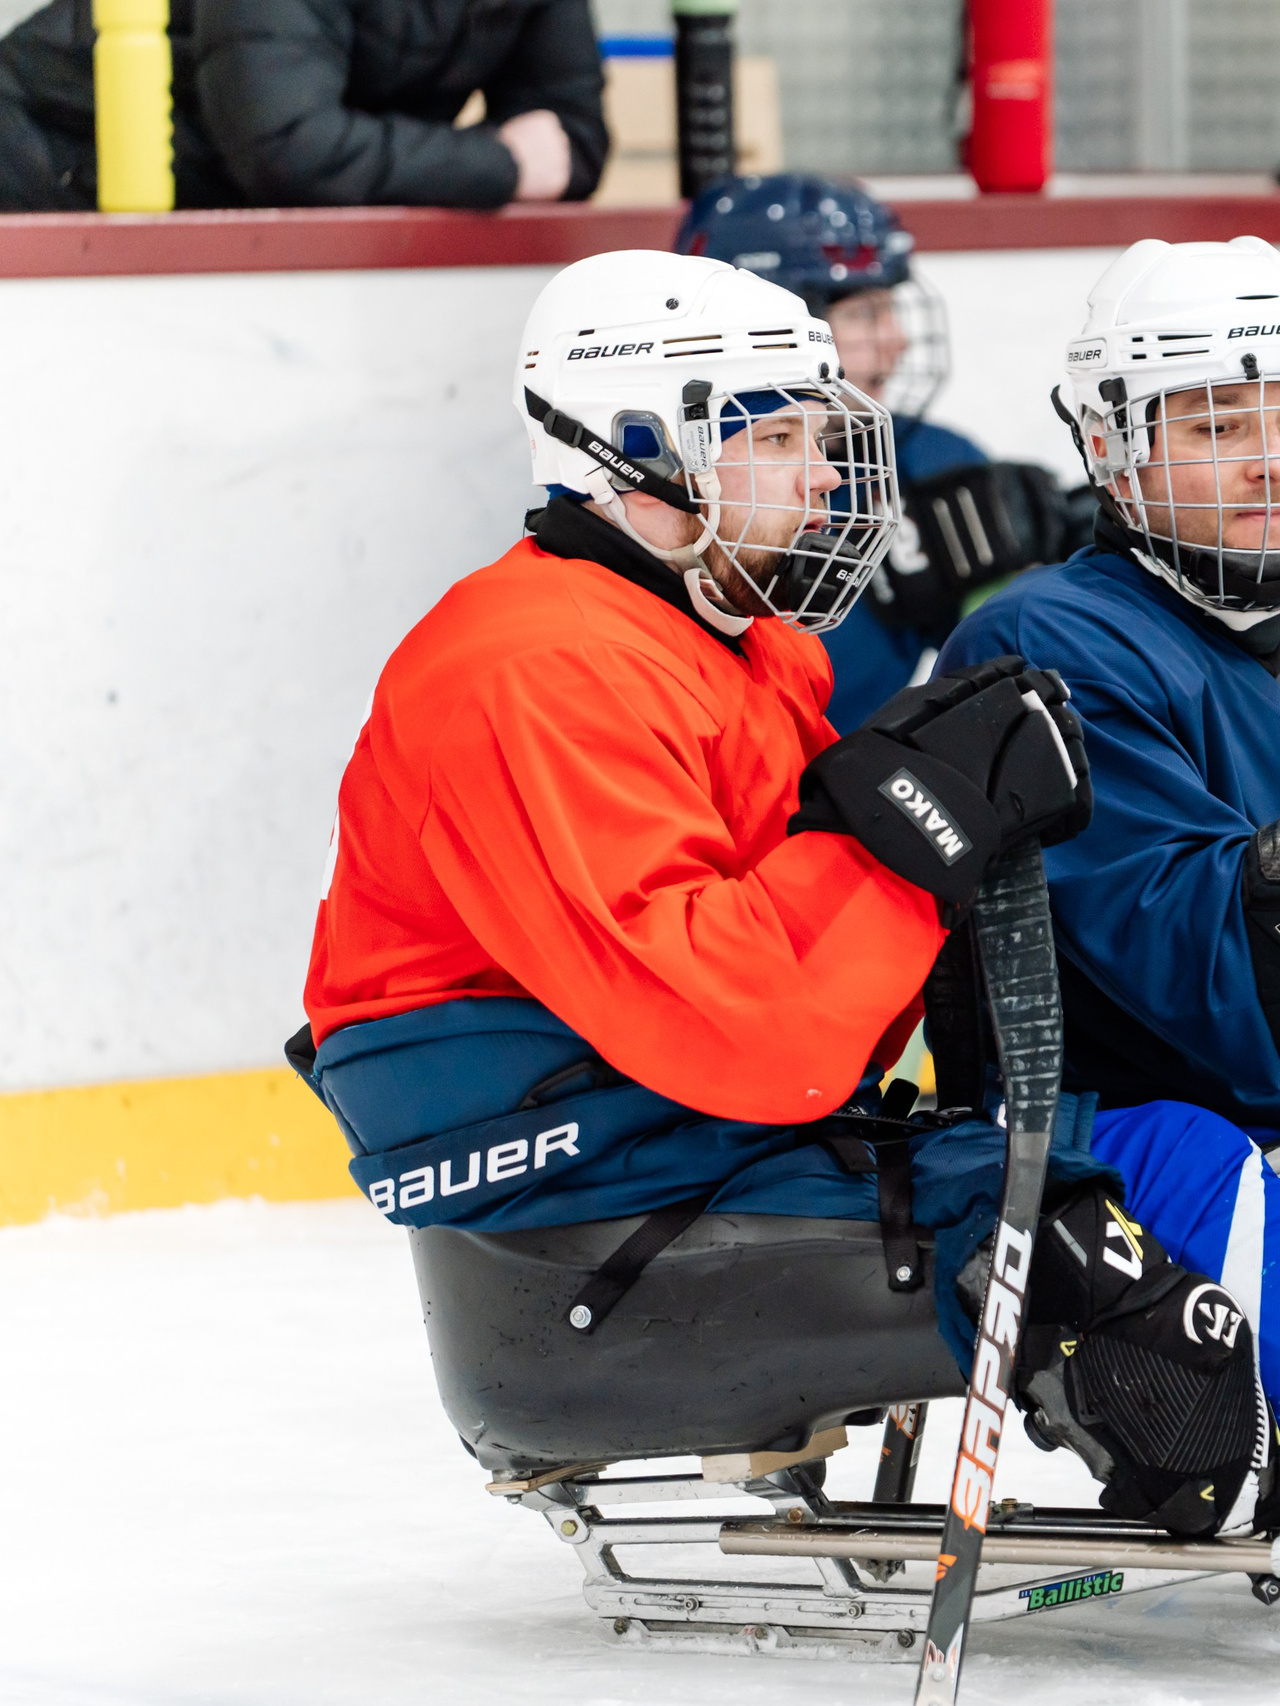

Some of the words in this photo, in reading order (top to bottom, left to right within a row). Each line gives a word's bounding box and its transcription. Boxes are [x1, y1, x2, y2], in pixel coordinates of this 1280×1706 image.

[567, 342, 654, 361] BAUER
[1068, 349, 1101, 362] BAUER
[588, 440, 645, 483] BAUER
[697, 425, 708, 468] BAUER
[890, 778, 964, 857] MAKO
[369, 1122, 581, 1215] BAUER
[1028, 1572, 1123, 1609] Ballistic
